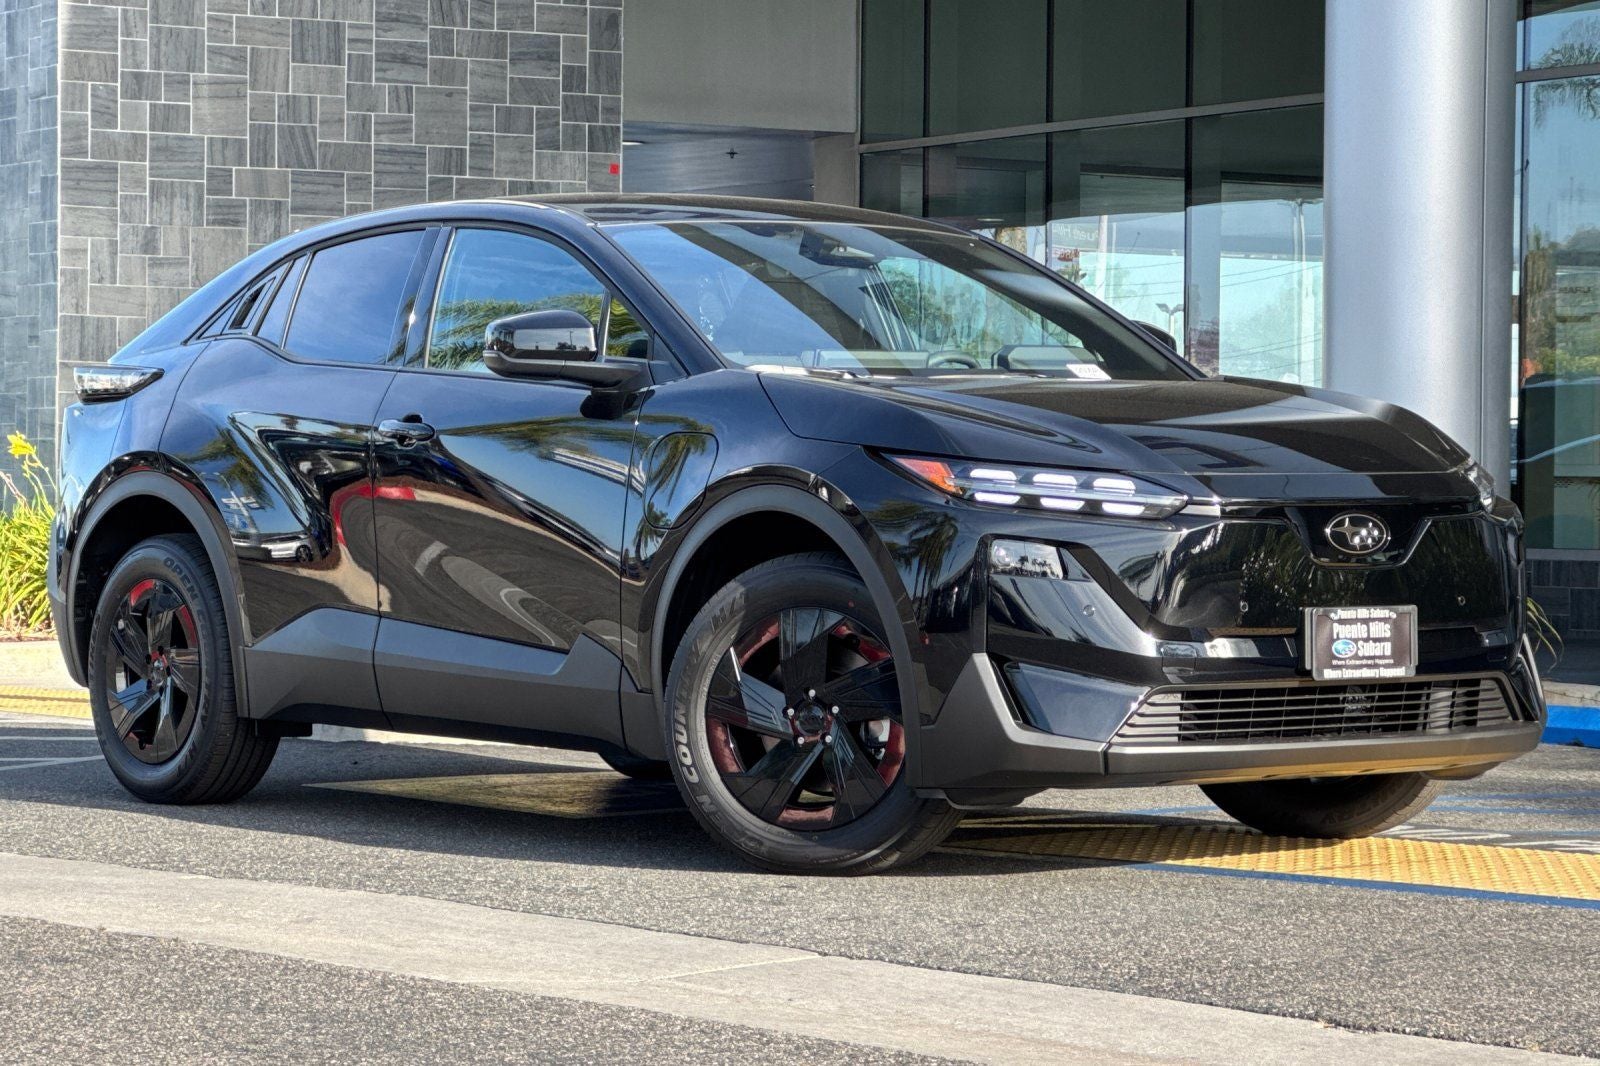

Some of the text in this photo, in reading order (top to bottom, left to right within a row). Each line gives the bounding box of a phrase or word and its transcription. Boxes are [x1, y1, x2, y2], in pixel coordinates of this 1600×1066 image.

[164, 557, 198, 600] OPEN
[1332, 621, 1391, 639] Puente Hills
[1357, 641, 1392, 657] Subaru
